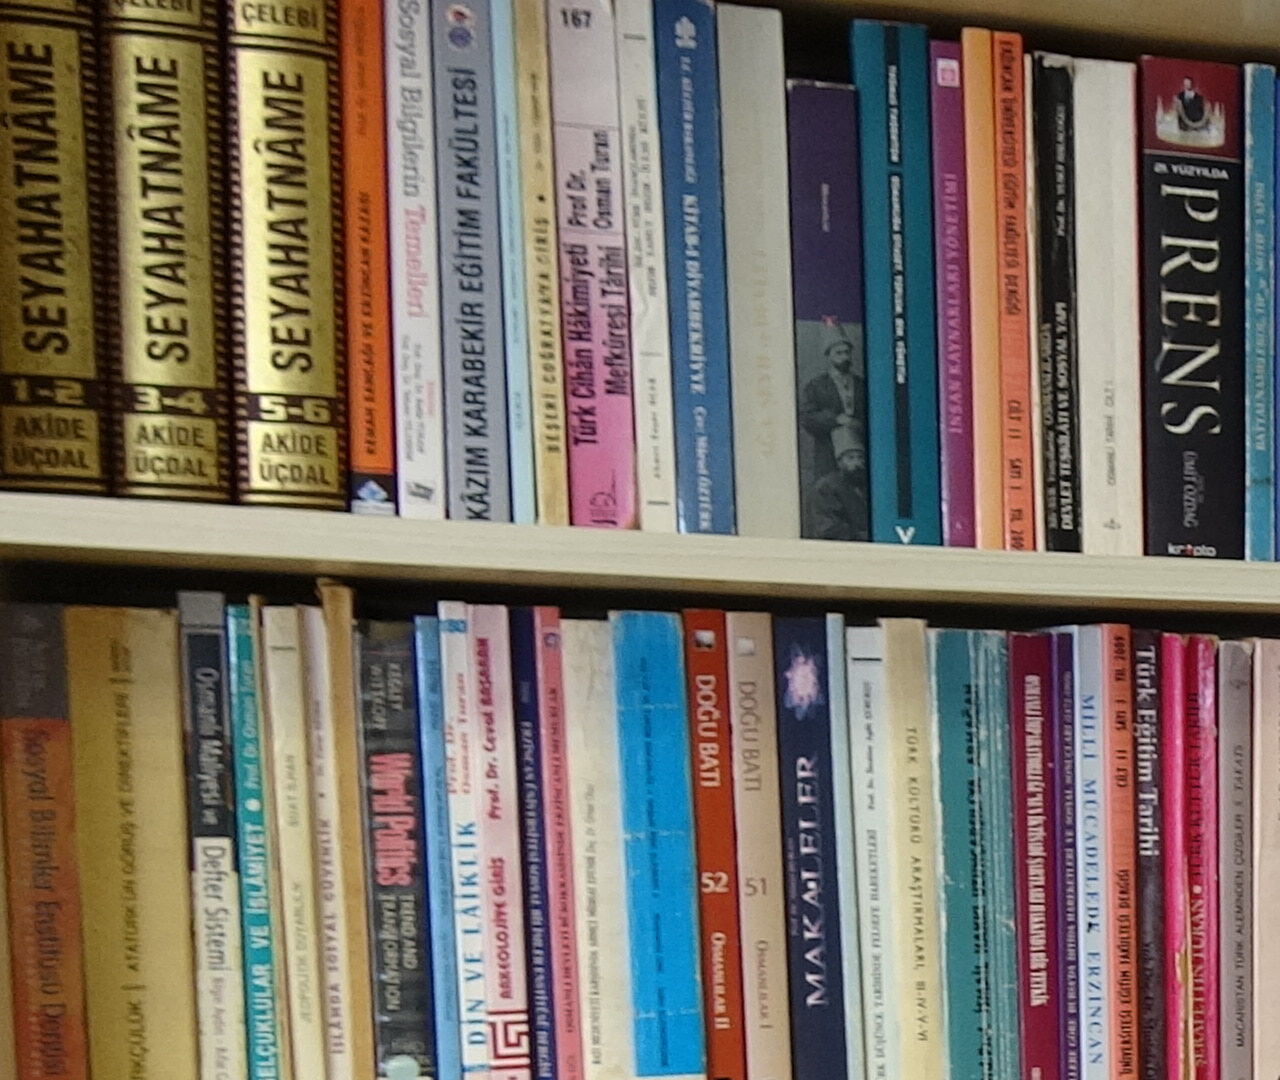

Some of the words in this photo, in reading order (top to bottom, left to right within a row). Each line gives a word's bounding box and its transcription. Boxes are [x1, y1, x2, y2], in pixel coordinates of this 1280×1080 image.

[446, 68, 481, 199] FAKÜLTESİ
[127, 54, 190, 364] SEYAHATNÂME
[253, 69, 312, 373] SEYAHATNÂME
[450, 209, 484, 293] EĞİTİM
[1159, 183, 1222, 435] PRENS
[454, 303, 488, 437] KARABEKİR
[571, 406, 597, 446] Türk
[696, 674, 718, 739] DOĞU
[1133, 646, 1156, 701] Türk
[697, 742, 720, 788] BATI
[739, 750, 762, 791] BATI
[1133, 708, 1158, 784] Eğitim
[1138, 787, 1159, 857] Tarihi
[204, 845, 231, 901] Defter
[796, 754, 830, 1007] MAKALELER
[205, 906, 234, 972] Sistemi
[252, 925, 269, 949] VE
[459, 949, 485, 982] VE
[462, 999, 487, 1045] DİN
